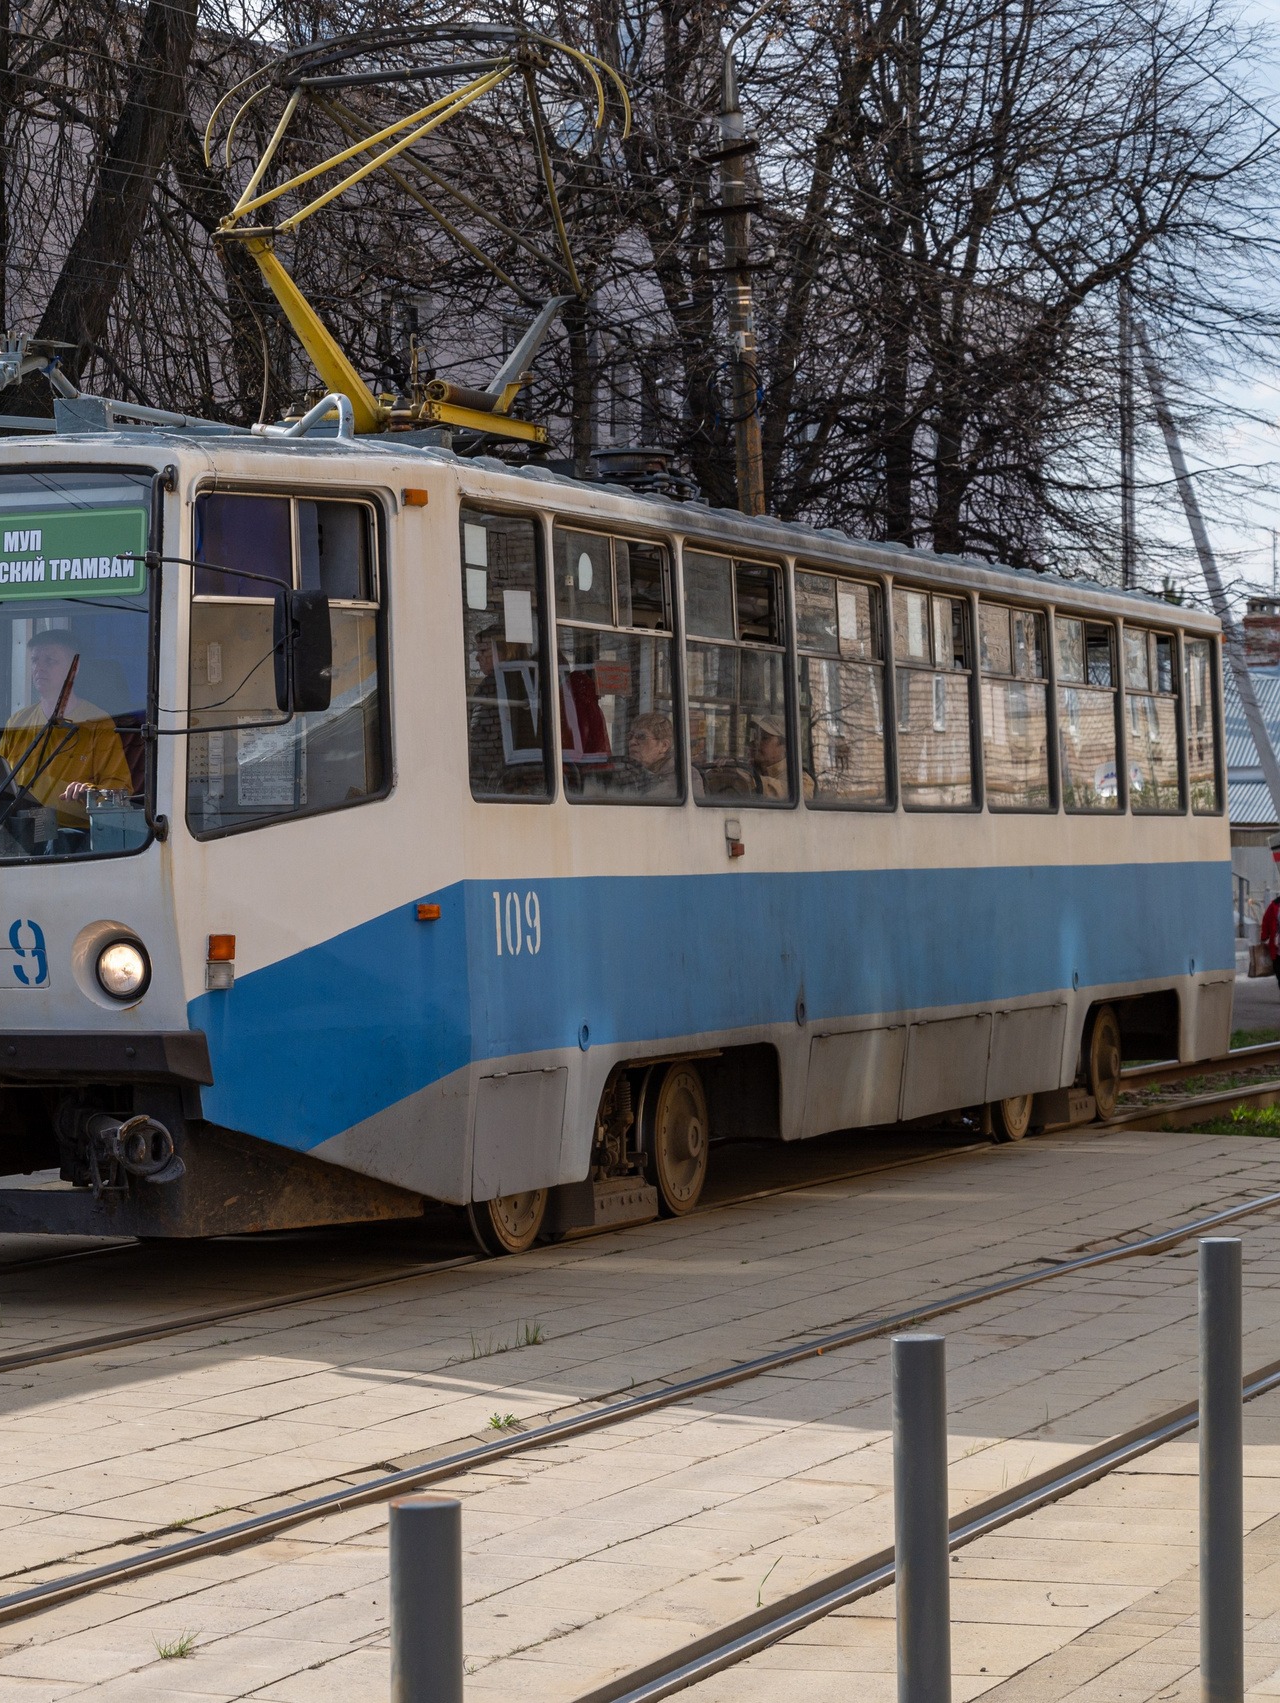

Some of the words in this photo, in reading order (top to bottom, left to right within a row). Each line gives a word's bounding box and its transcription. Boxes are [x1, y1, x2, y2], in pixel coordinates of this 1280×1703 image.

[4, 529, 42, 553] МУП
[49, 551, 135, 581] ТРАМВАЙ
[492, 890, 541, 956] 109
